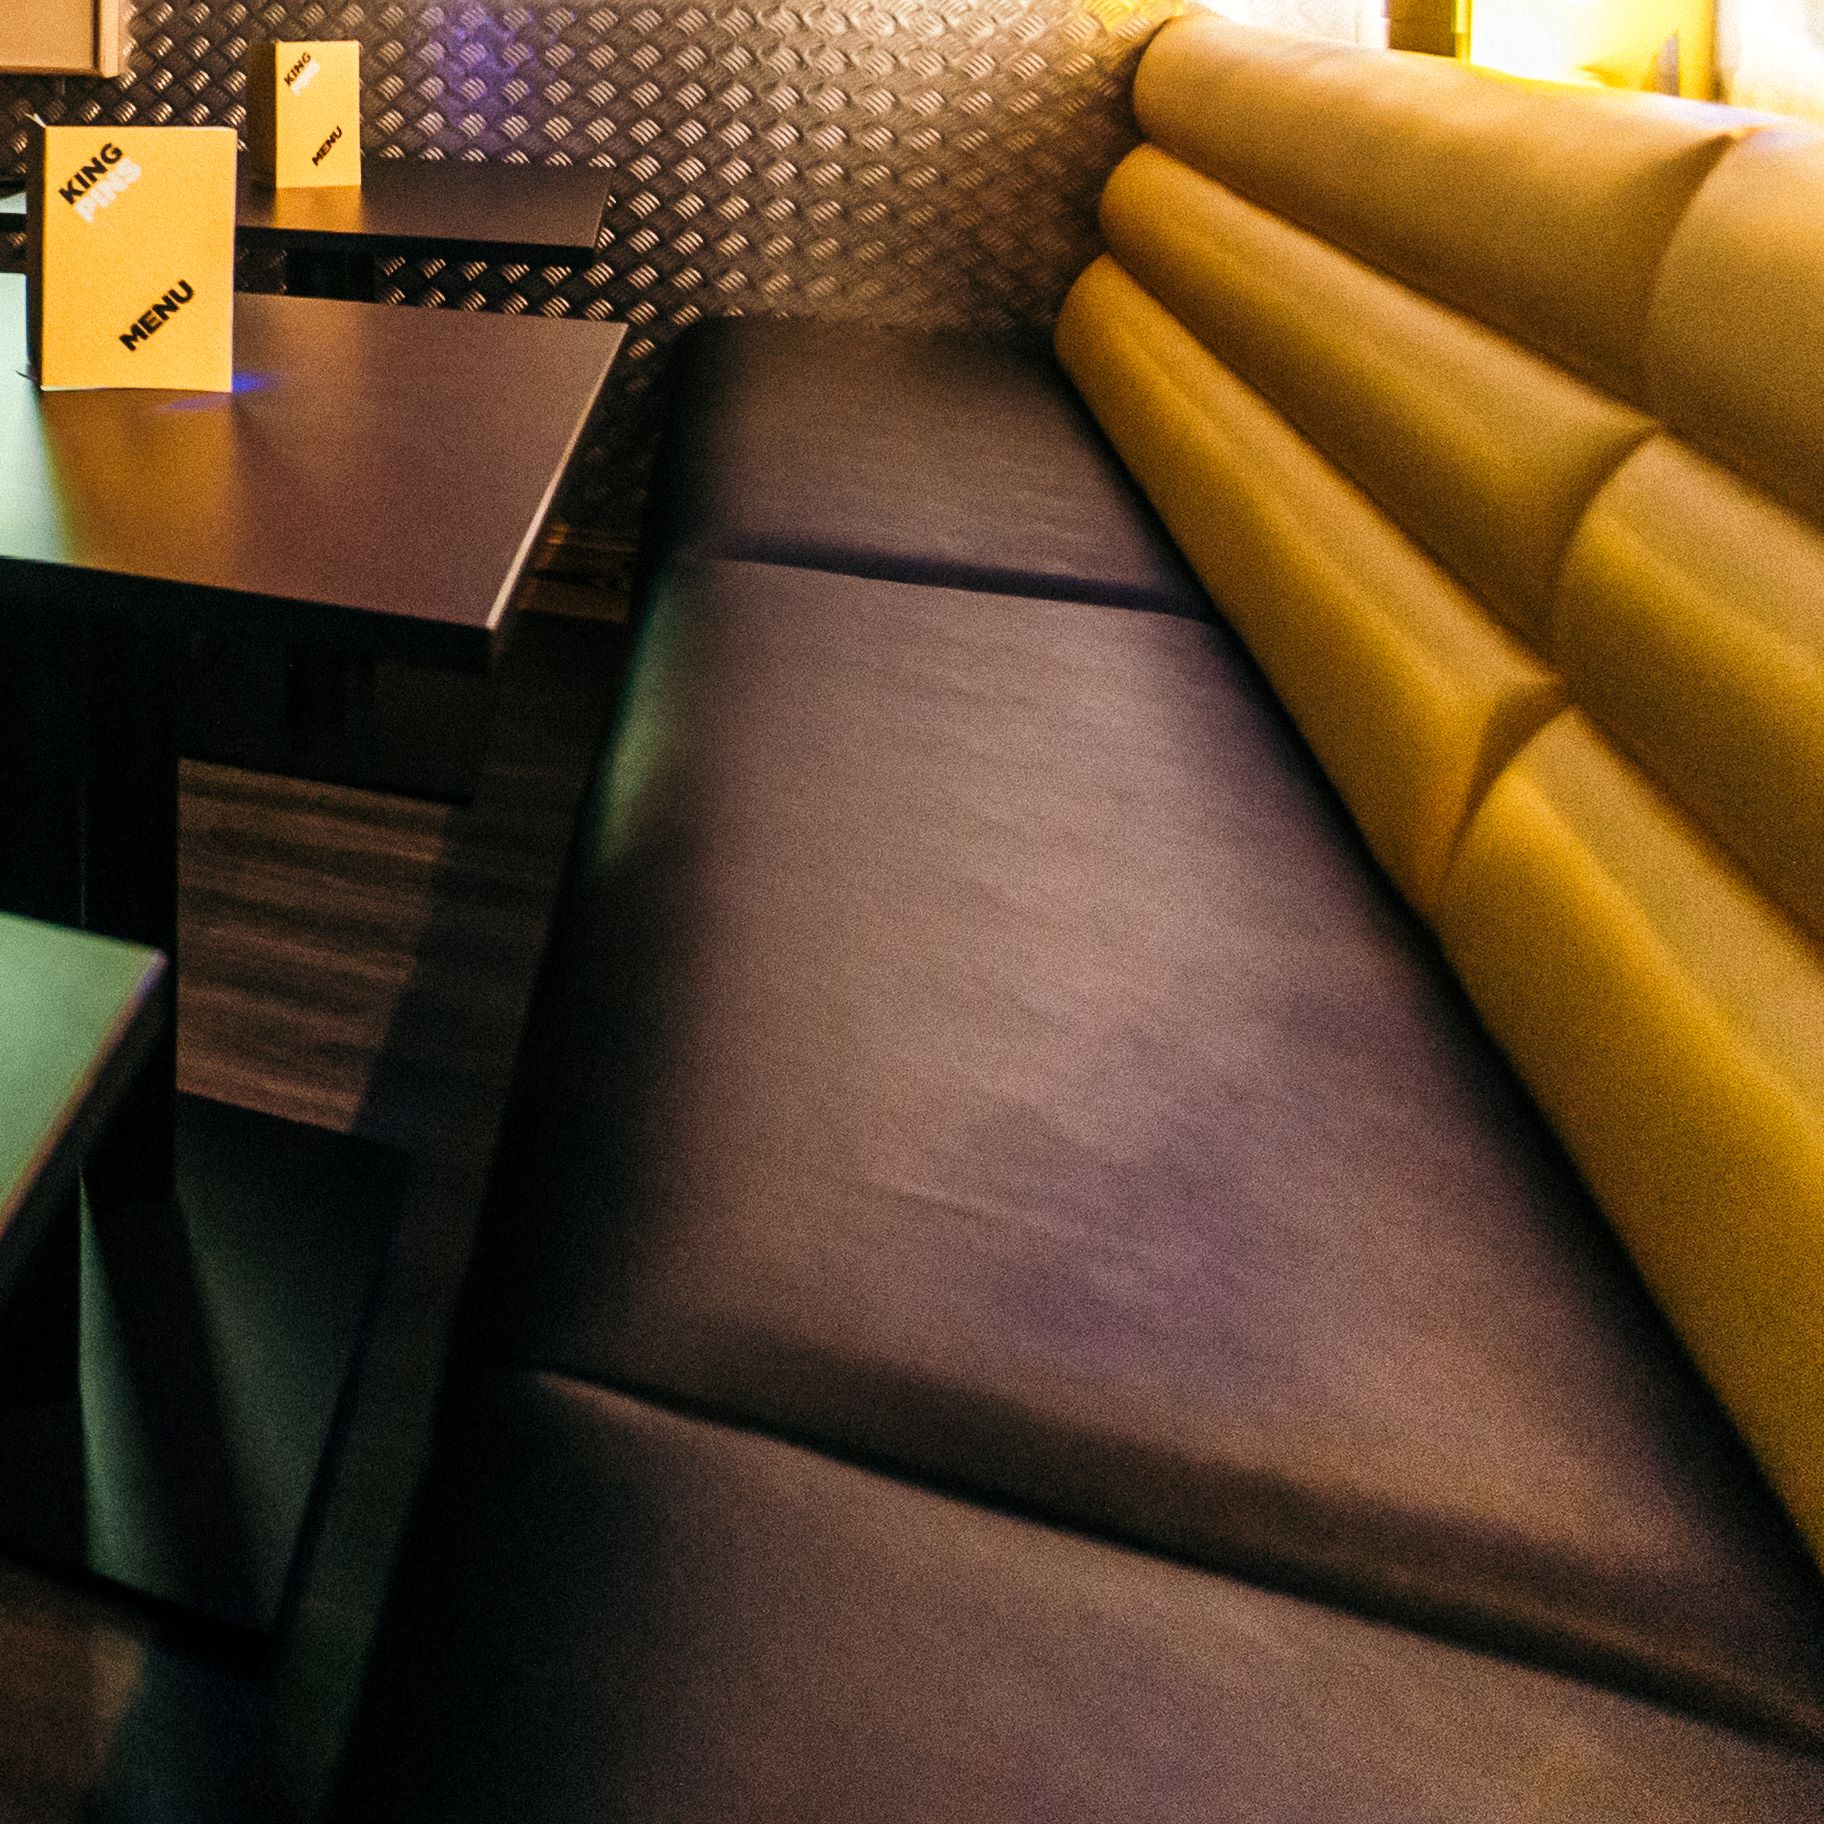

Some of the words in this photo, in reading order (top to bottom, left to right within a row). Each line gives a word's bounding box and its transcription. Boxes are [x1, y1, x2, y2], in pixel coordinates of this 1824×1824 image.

[283, 51, 312, 87] KING
[311, 125, 343, 166] MENU
[58, 141, 124, 206] KING
[118, 278, 195, 353] MENU
